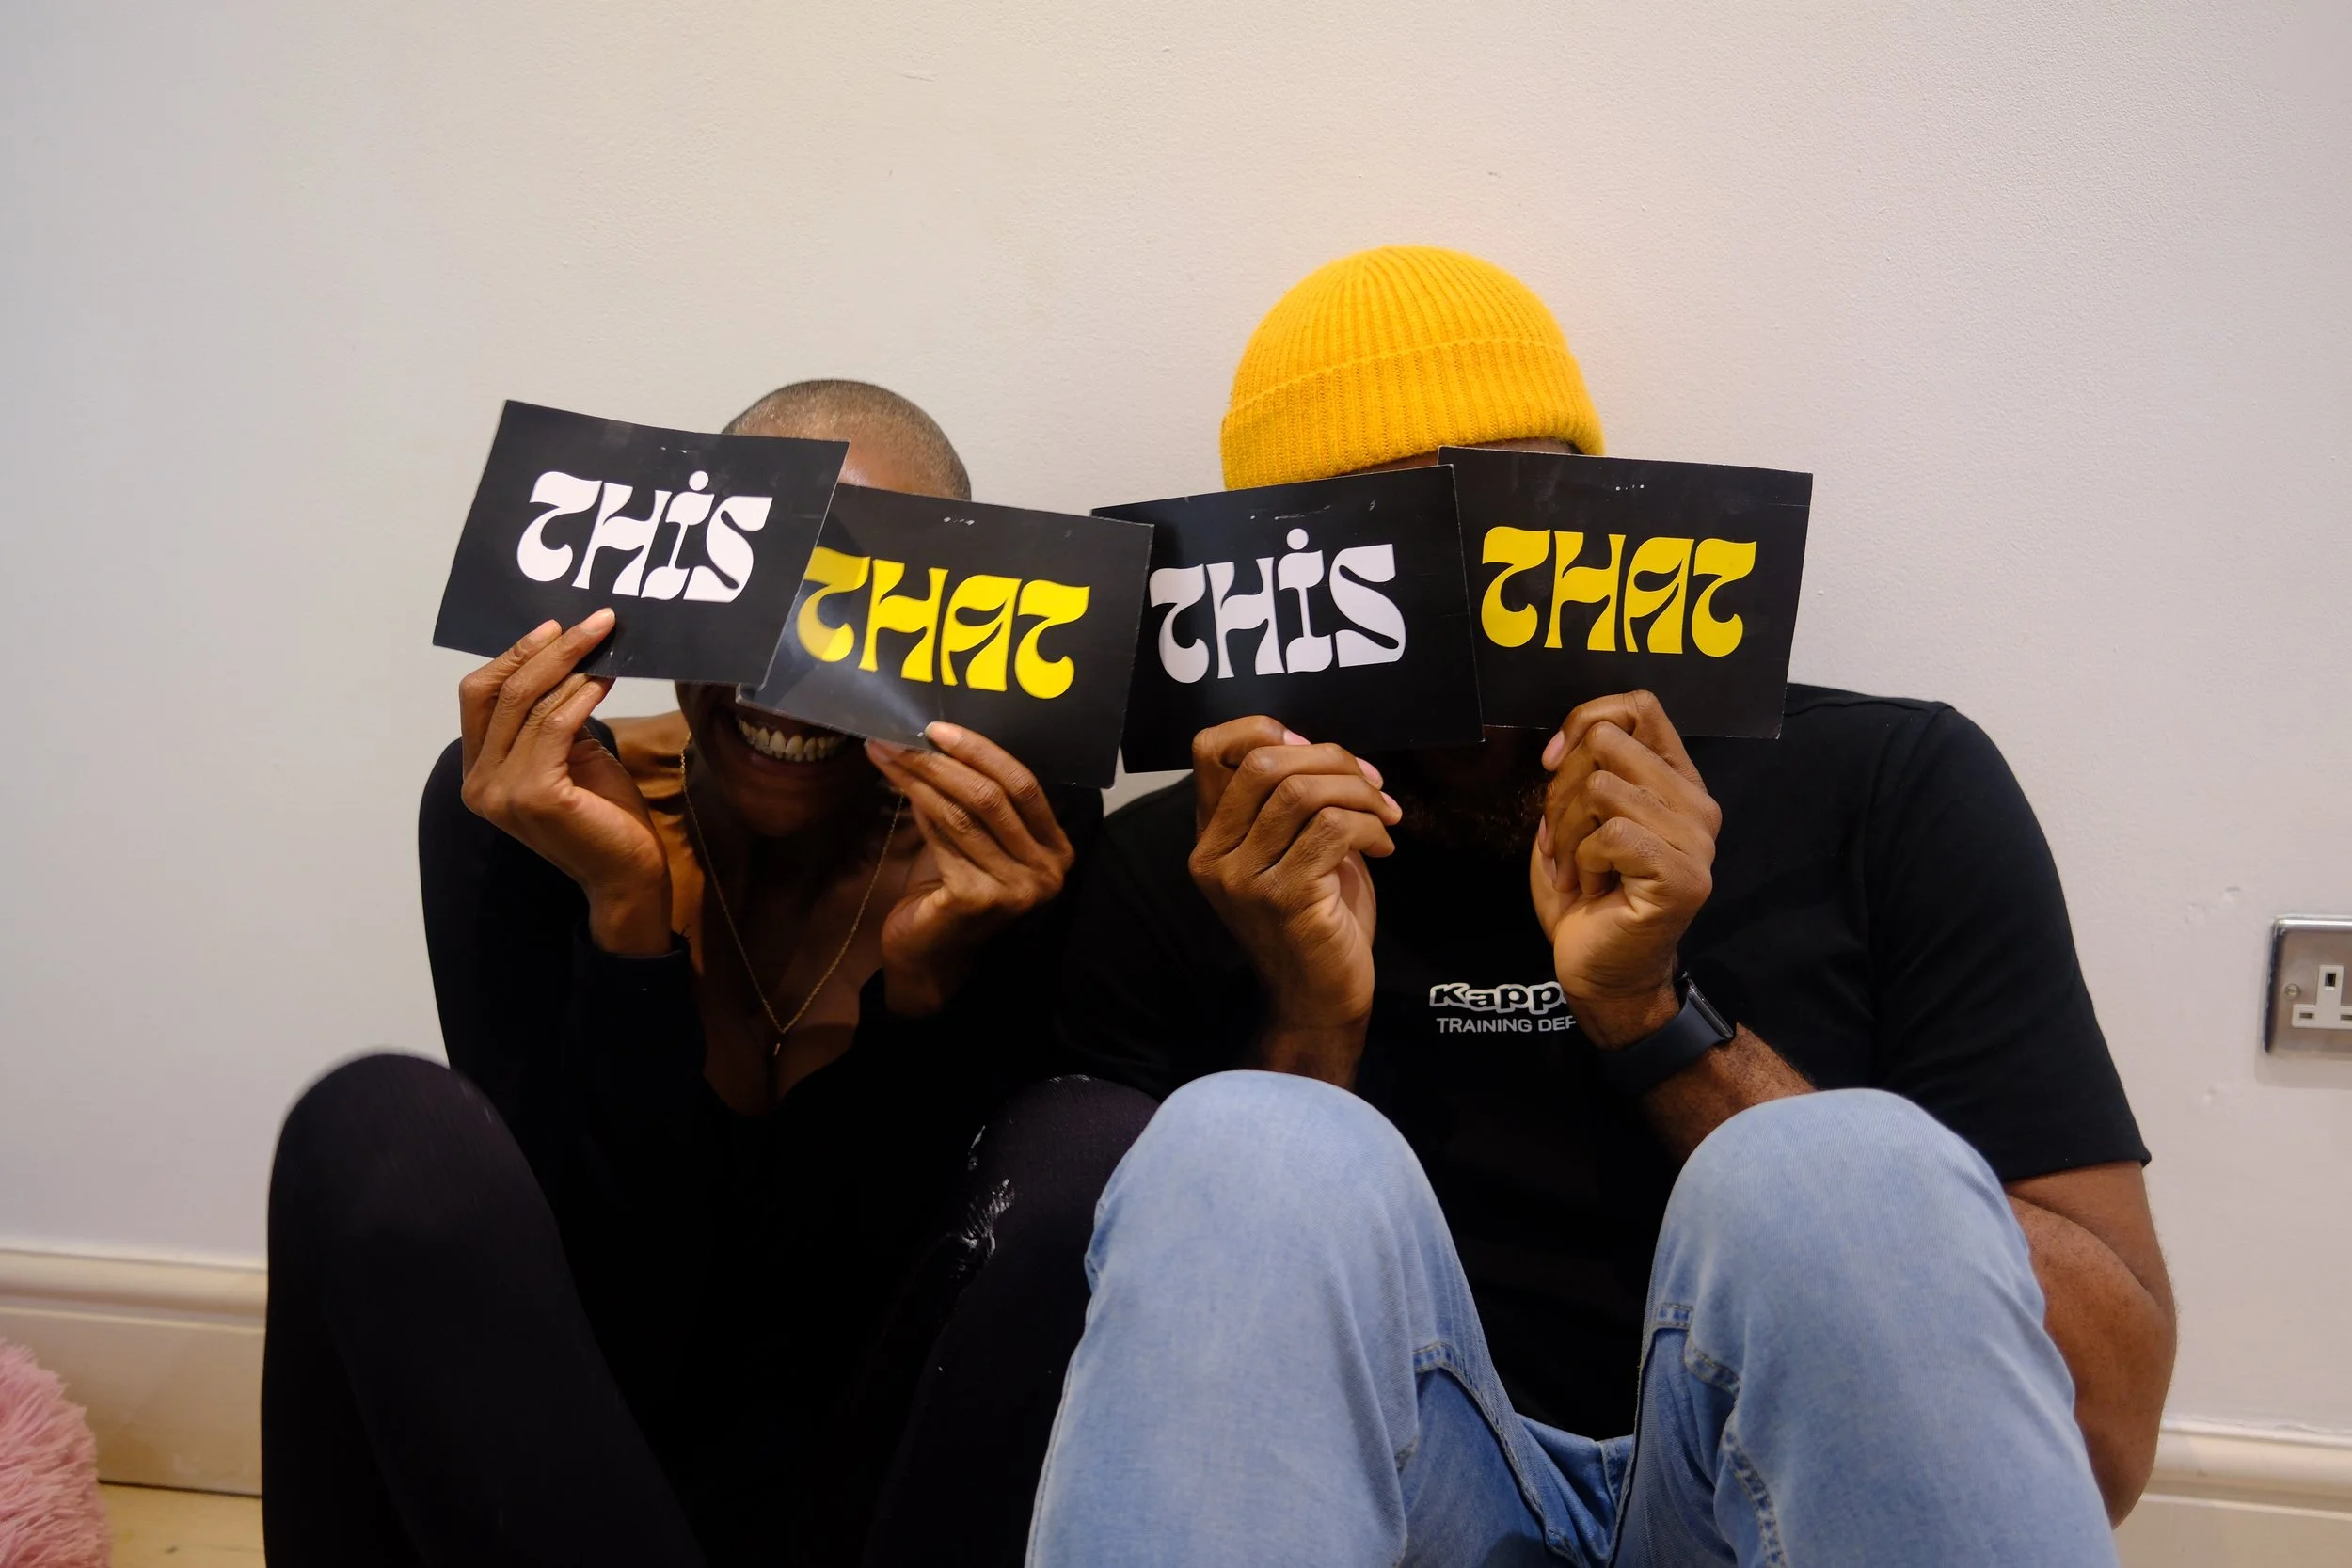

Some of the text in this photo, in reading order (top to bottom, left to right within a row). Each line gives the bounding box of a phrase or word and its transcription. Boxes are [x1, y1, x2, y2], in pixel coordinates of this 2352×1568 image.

[796, 546, 1091, 700] THAT
[1481, 525, 1757, 657] THAT
[1429, 981, 1567, 1015] Kapp
[1436, 1017, 1533, 1033] TRAINING
